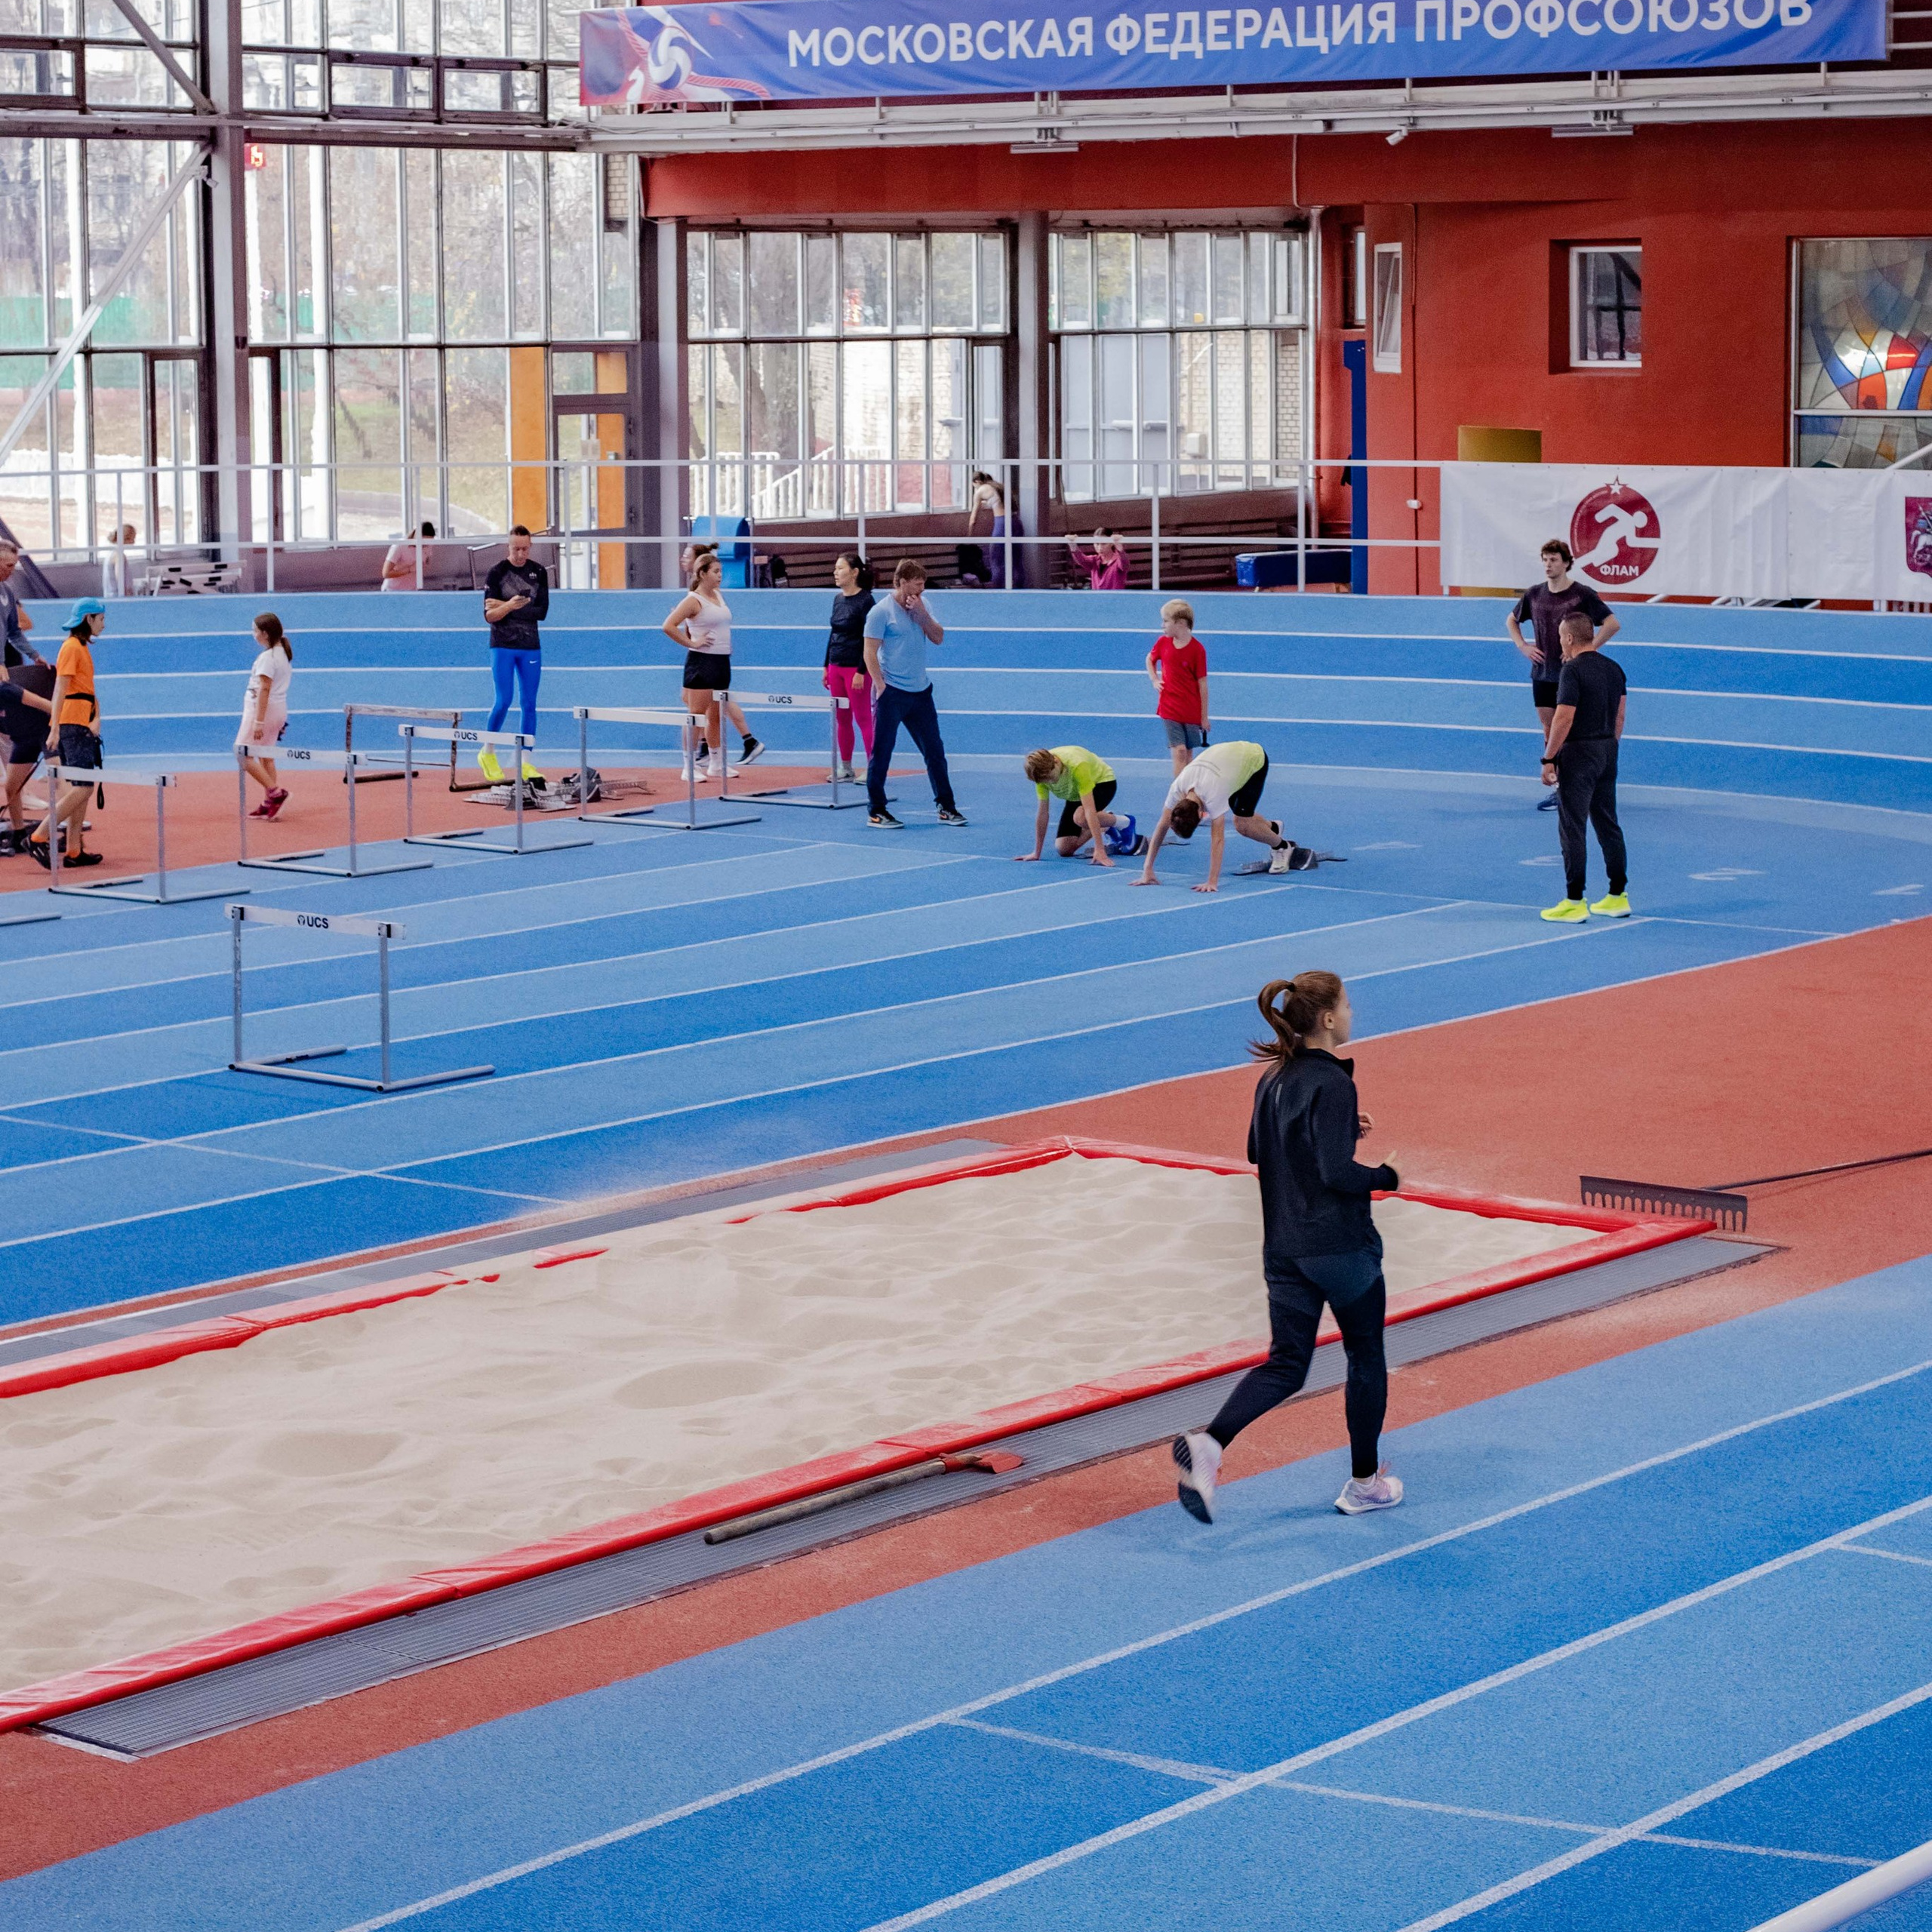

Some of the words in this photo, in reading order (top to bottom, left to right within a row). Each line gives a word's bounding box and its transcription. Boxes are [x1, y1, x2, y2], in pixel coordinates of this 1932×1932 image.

[788, 16, 1094, 68] МОСКОВСКАЯ
[1105, 2, 1396, 60] ФЕДЕРАЦИЯ
[1415, 0, 1814, 42] ПРОФСОЮЗОВ
[1599, 564, 1639, 577] ФЛАМ
[775, 696, 792, 704] UCS
[461, 731, 478, 741] UCS
[294, 750, 311, 760] UCS
[306, 915, 329, 929] UCS
